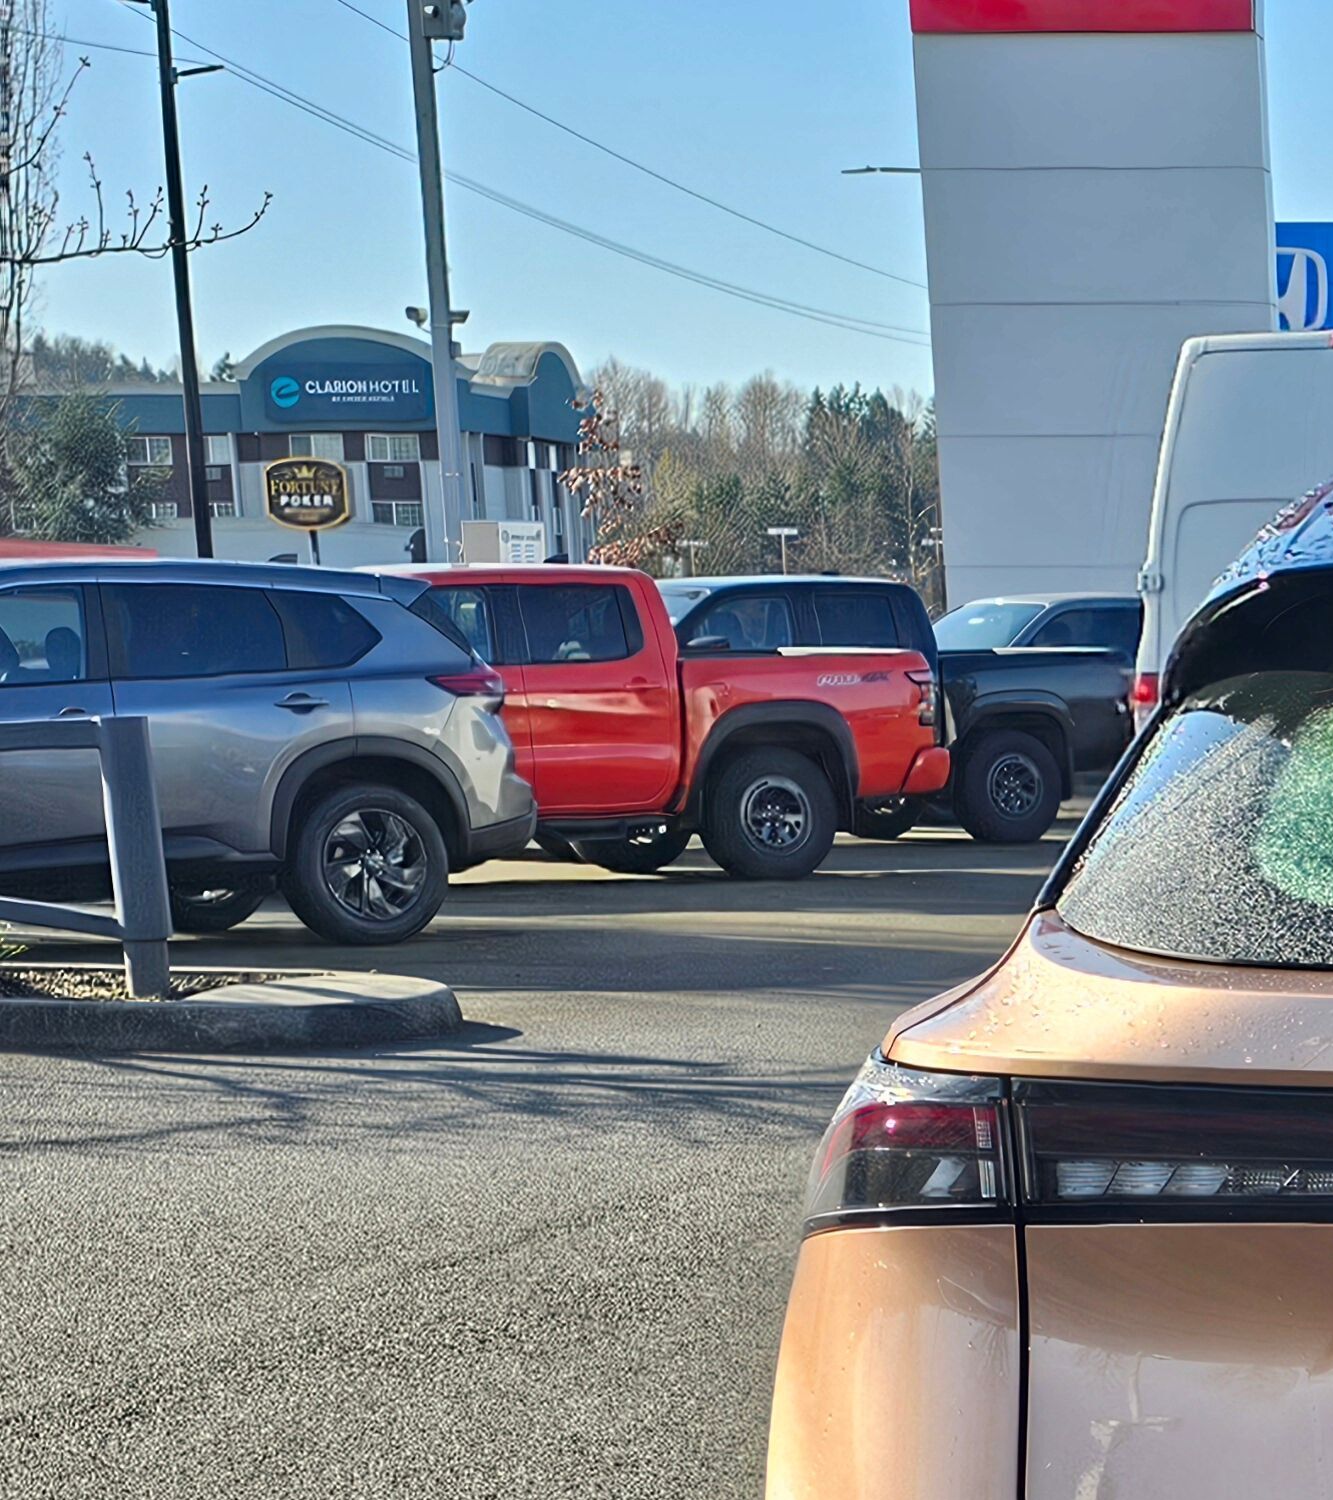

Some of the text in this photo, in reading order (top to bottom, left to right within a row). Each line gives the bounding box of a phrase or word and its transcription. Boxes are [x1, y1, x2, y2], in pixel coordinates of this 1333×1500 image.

[305, 380, 419, 394] CLARION HOTEL
[271, 479, 341, 496] FORTUNE
[280, 494, 334, 507] POKER
